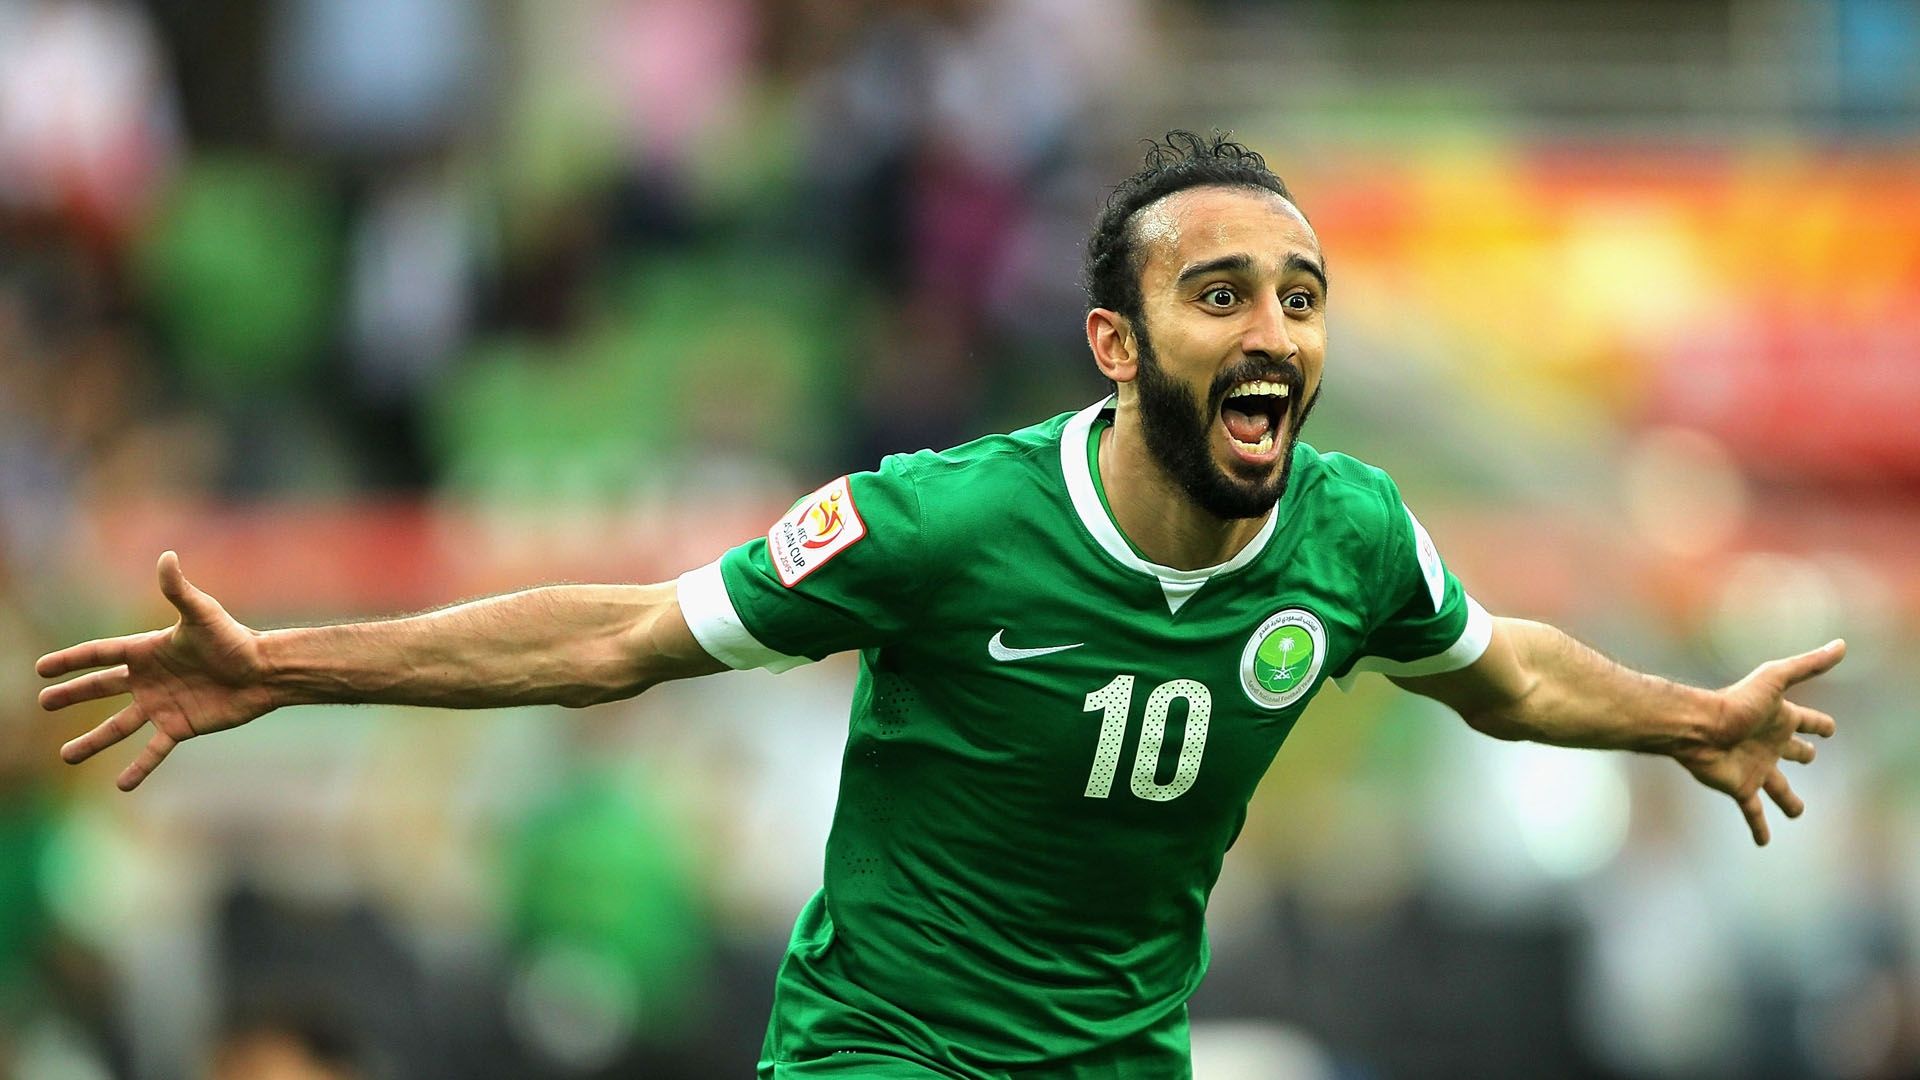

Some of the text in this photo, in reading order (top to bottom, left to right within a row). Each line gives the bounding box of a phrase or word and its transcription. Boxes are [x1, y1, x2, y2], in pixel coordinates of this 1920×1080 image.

[783, 522, 806, 567] ASIAN CUP
[797, 527, 808, 543] AFC
[1083, 674, 1212, 802] 10
